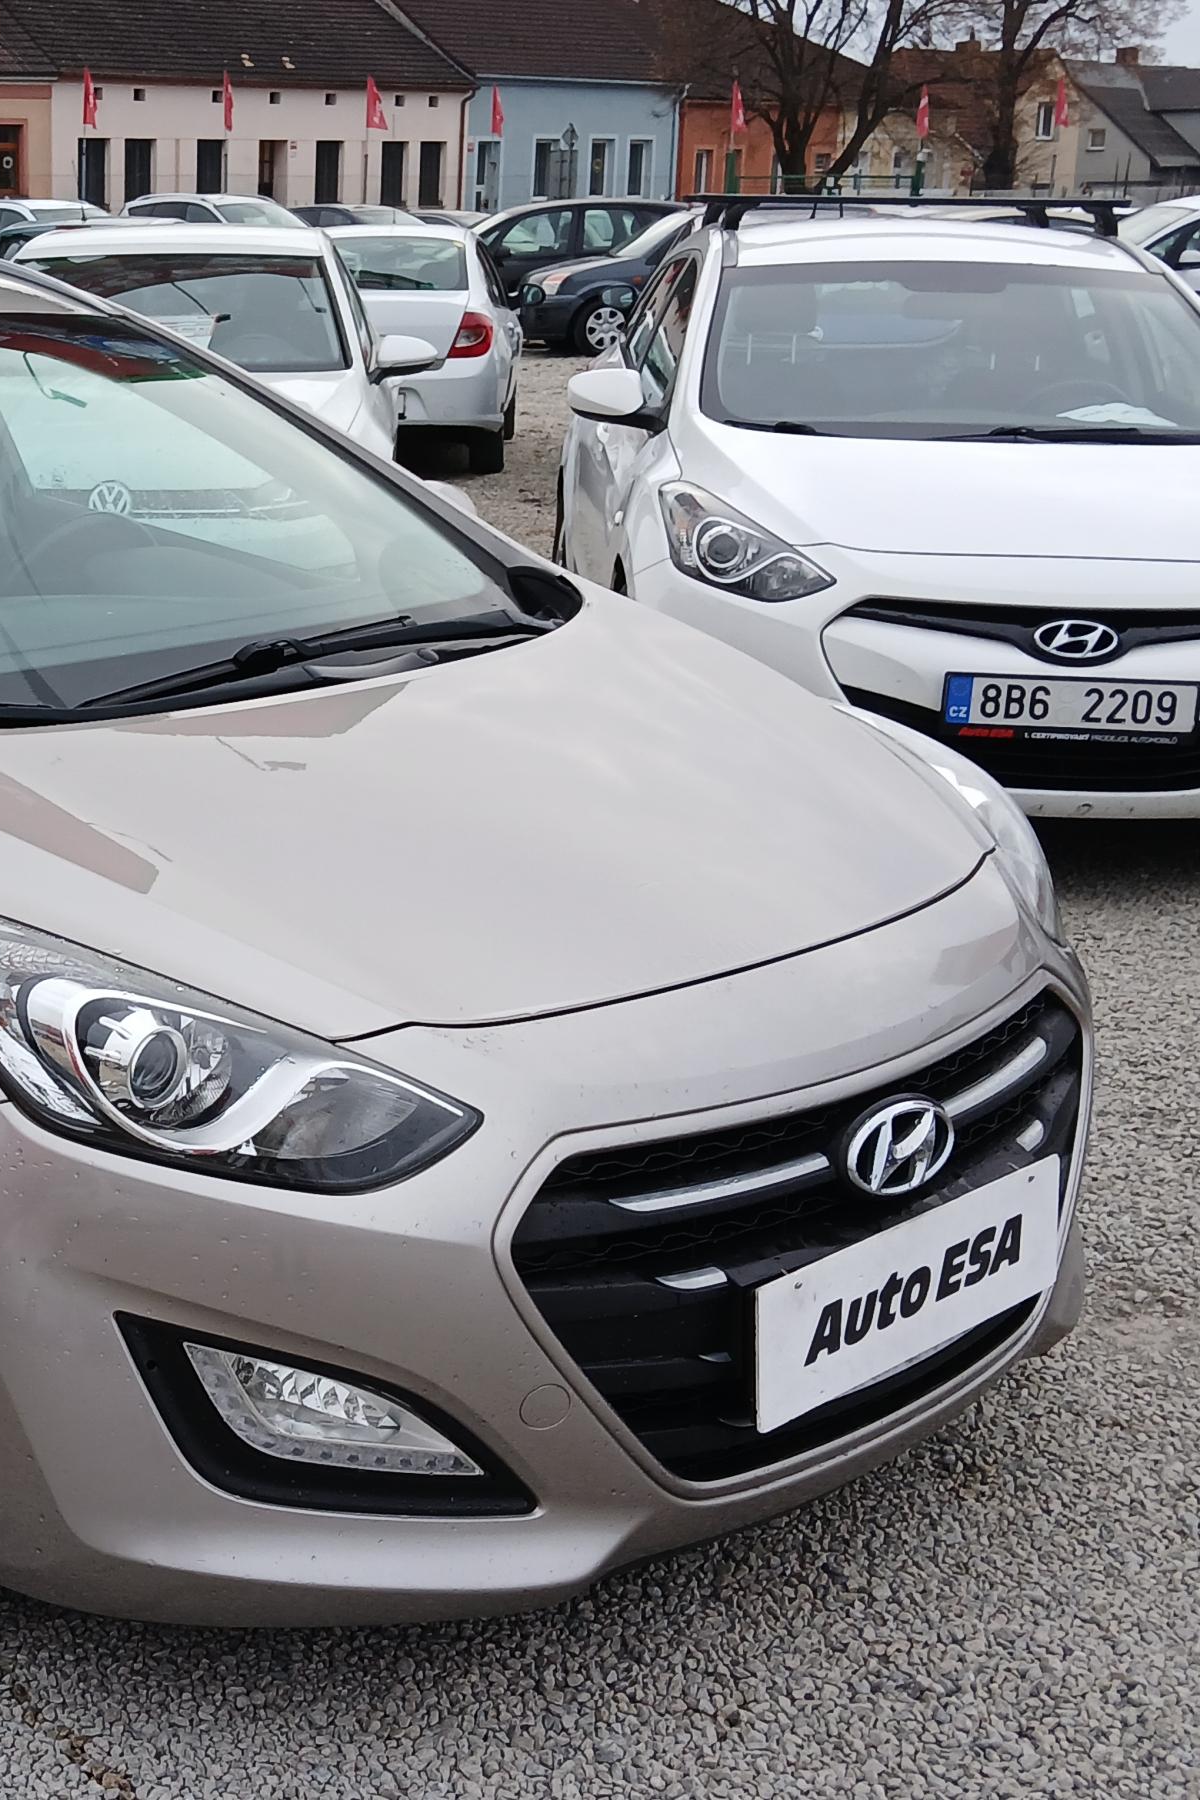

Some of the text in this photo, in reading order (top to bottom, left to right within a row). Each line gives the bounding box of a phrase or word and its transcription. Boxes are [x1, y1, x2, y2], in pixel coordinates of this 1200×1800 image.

[948, 706, 968, 718] CZ
[980, 683, 1178, 726] 8B6 2209
[804, 1213, 1022, 1367] Auto ESA
